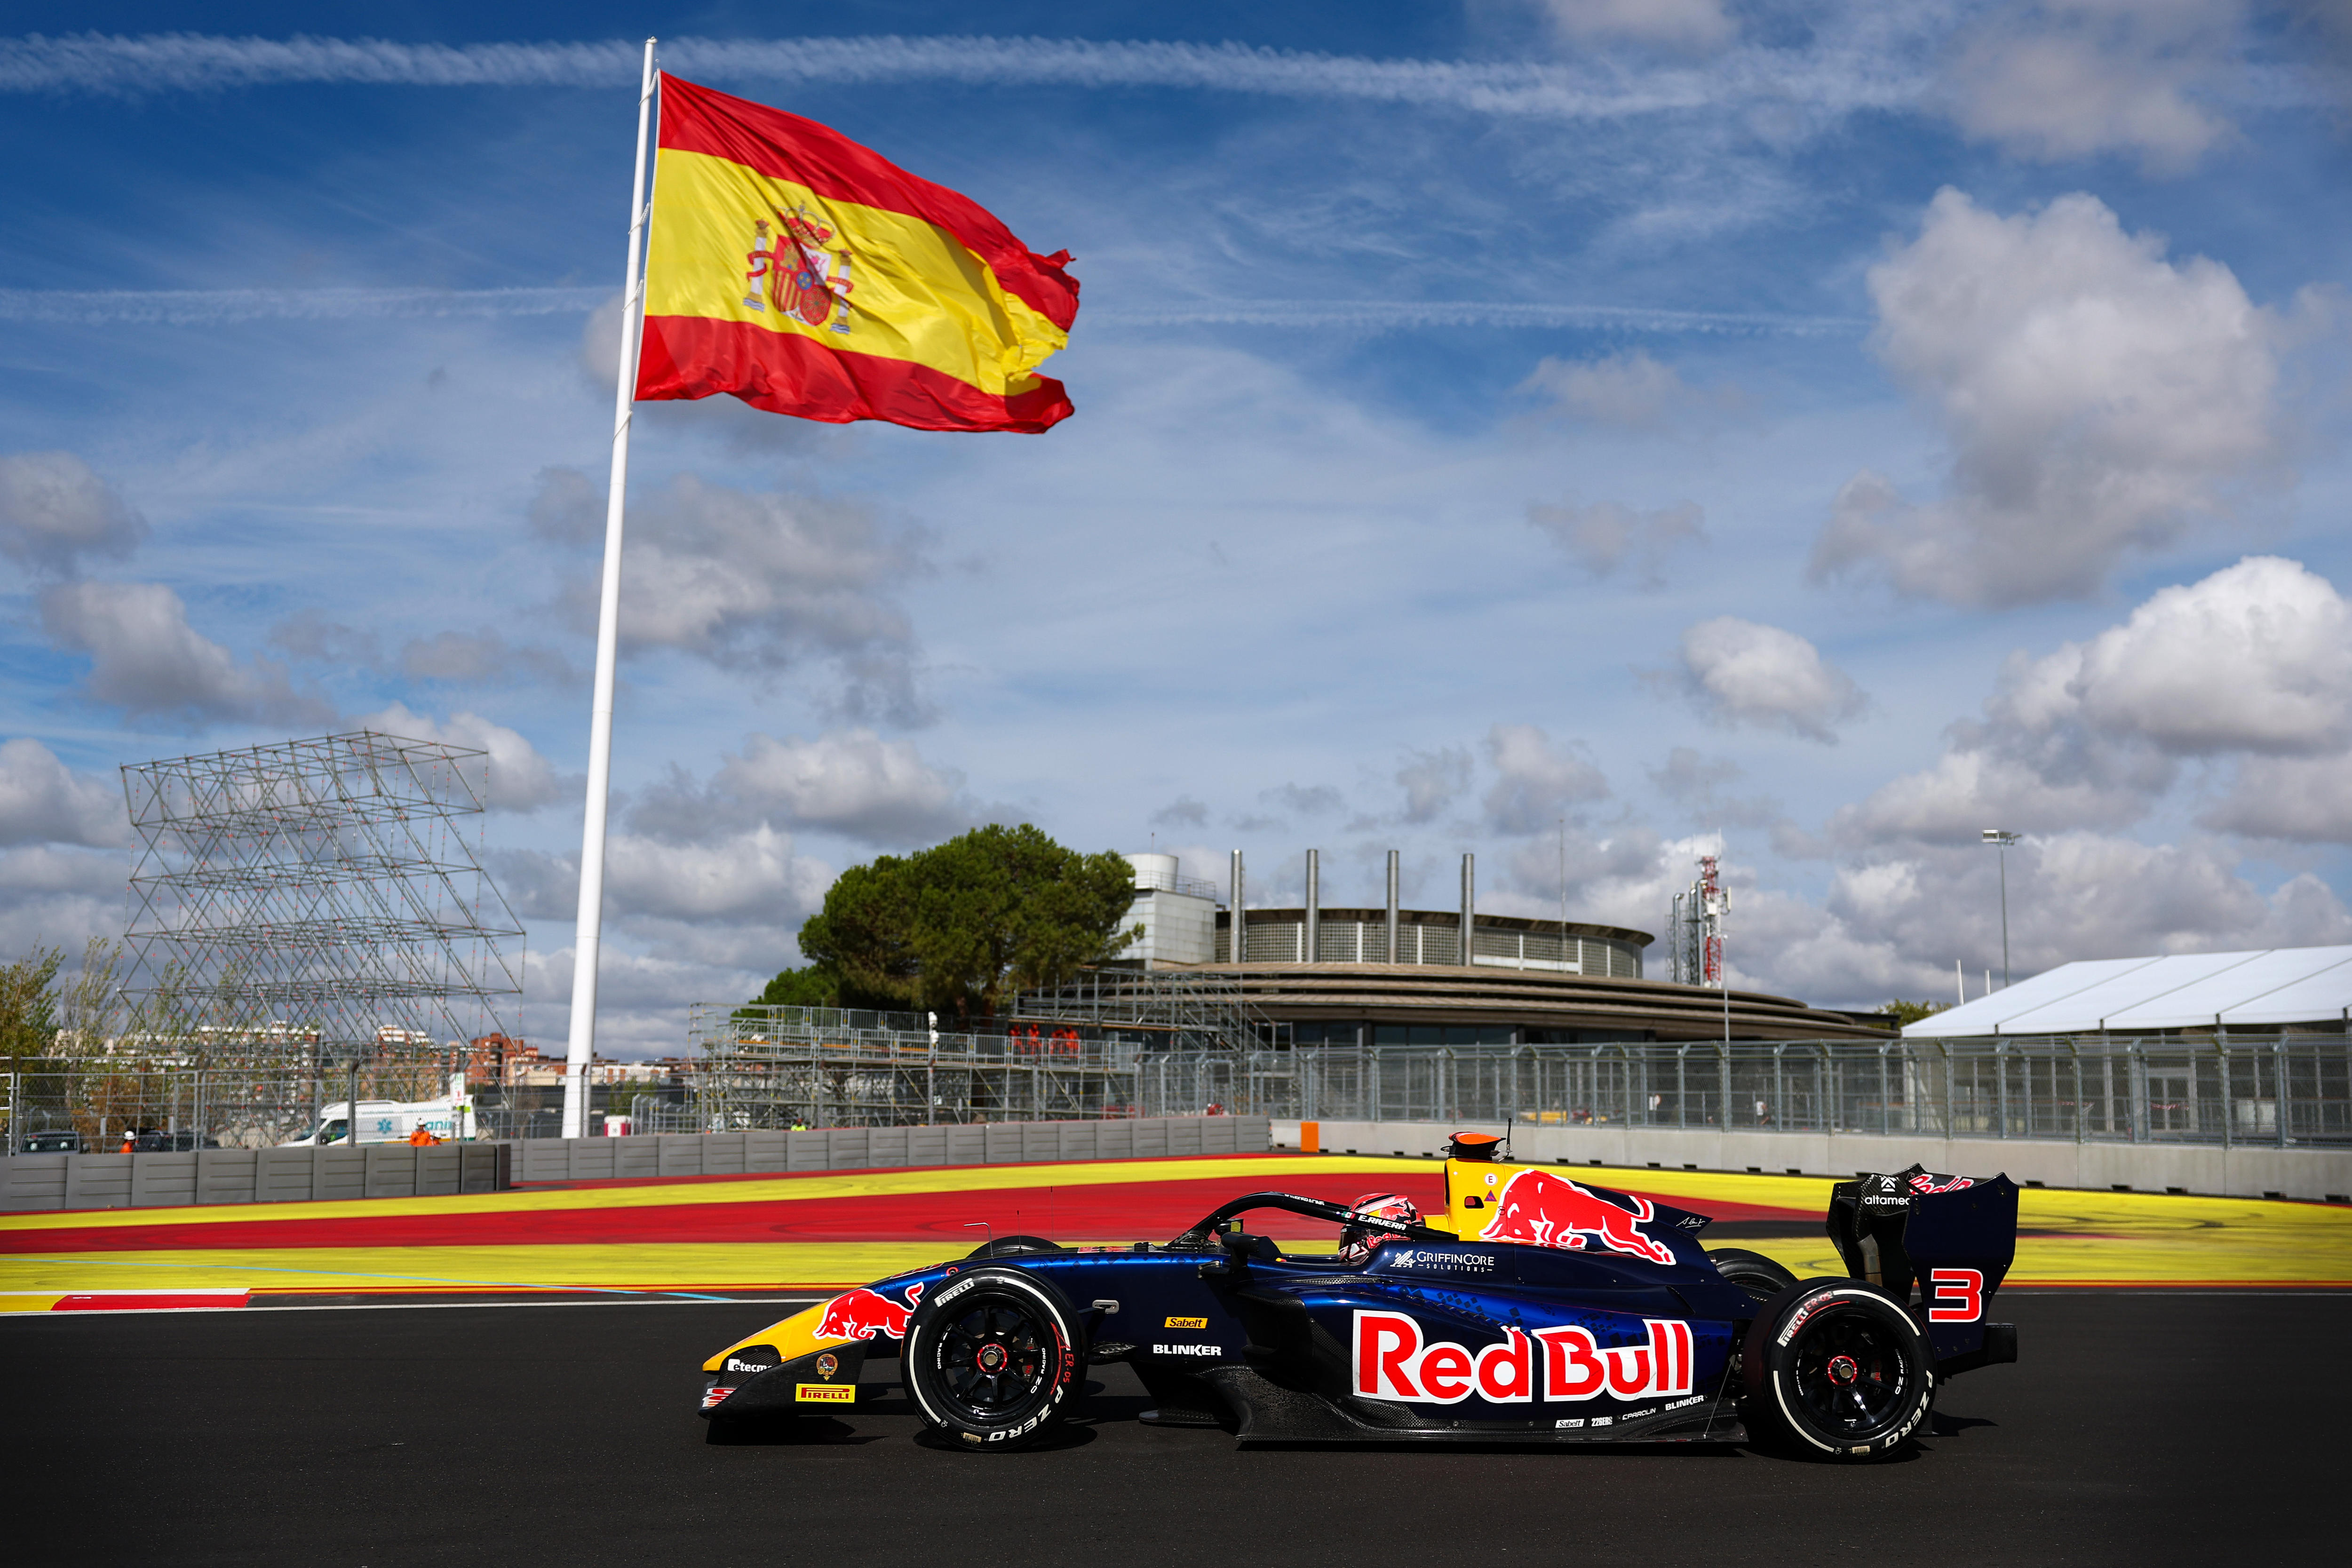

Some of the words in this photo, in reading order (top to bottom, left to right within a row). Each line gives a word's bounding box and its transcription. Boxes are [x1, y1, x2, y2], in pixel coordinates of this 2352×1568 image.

[1358, 1215, 1407, 1231] E.RIVERA
[1426, 1263, 1485, 1273] SOLUTIONS
[934, 1278, 975, 1307] PIRELLI
[1930, 1268, 1983, 1322] 3
[1169, 1318, 1203, 1328] Sabelt
[1777, 1307, 1809, 1347] PIRELLI
[1153, 1344, 1222, 1356] BLINKER
[1357, 1313, 1532, 1402] Red
[1536, 1321, 1692, 1398] Bull
[1926, 1370, 1933, 1388] P
[801, 1387, 850, 1400] PIRELLI
[1055, 1385, 1064, 1404] P
[1665, 1395, 1704, 1411] BLINKER
[988, 1404, 1051, 1441] ZERO
[1591, 1417, 1613, 1427] 226ERS
[1885, 1391, 1929, 1448] ZERO
